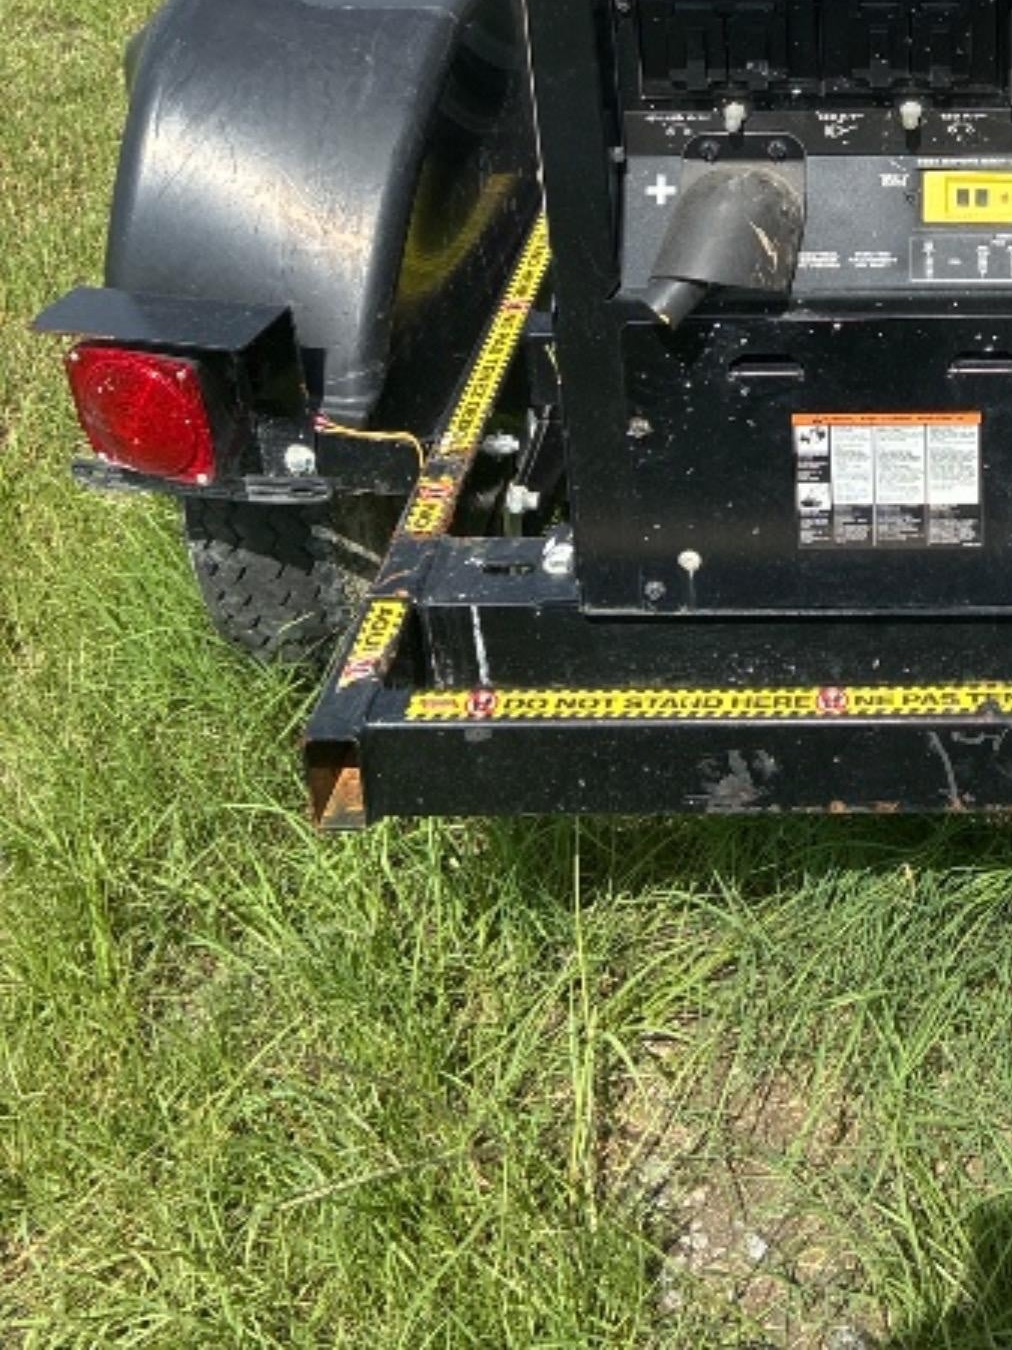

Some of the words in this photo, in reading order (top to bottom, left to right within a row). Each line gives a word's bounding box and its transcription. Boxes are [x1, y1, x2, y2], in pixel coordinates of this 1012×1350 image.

[503, 697, 549, 709] DO
[554, 697, 613, 709] NOT
[623, 696, 724, 709] STAND
[731, 695, 812, 709] HERE
[854, 695, 893, 706] NE
[902, 694, 961, 706] PAS
